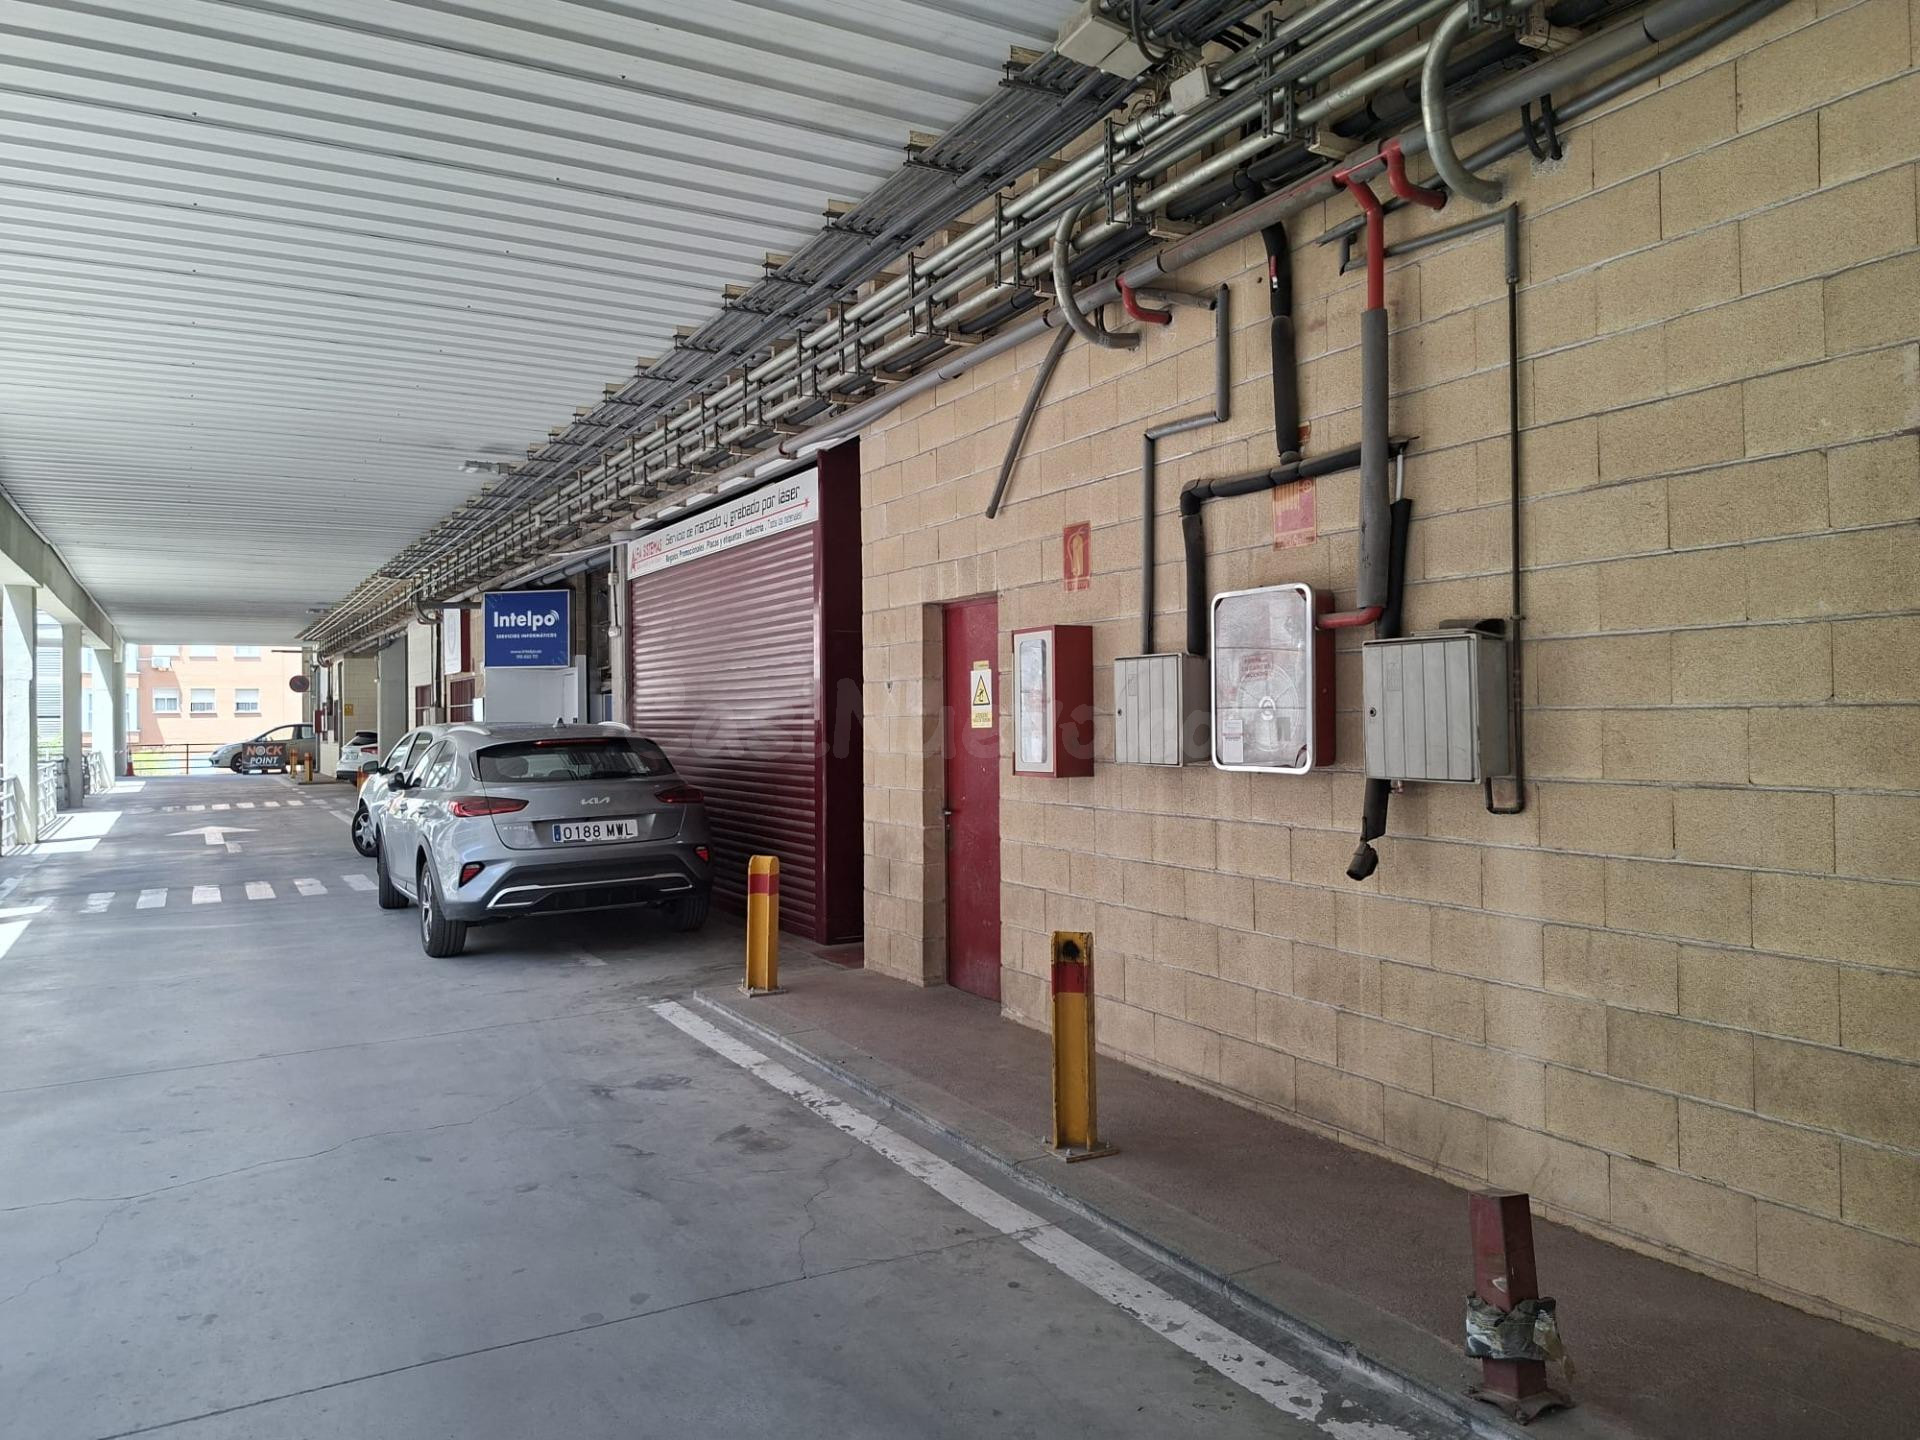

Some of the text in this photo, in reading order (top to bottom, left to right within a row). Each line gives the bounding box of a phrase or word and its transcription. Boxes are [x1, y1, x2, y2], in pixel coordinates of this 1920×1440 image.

[694, 513, 721, 536] marcado
[724, 513, 729, 528] y
[730, 499, 760, 526] grabado
[762, 495, 775, 515] por
[494, 610, 556, 631] Intelpo
[246, 745, 282, 756] NOCK
[250, 756, 279, 765] POINT
[563, 822, 634, 840] 0188 MWL
